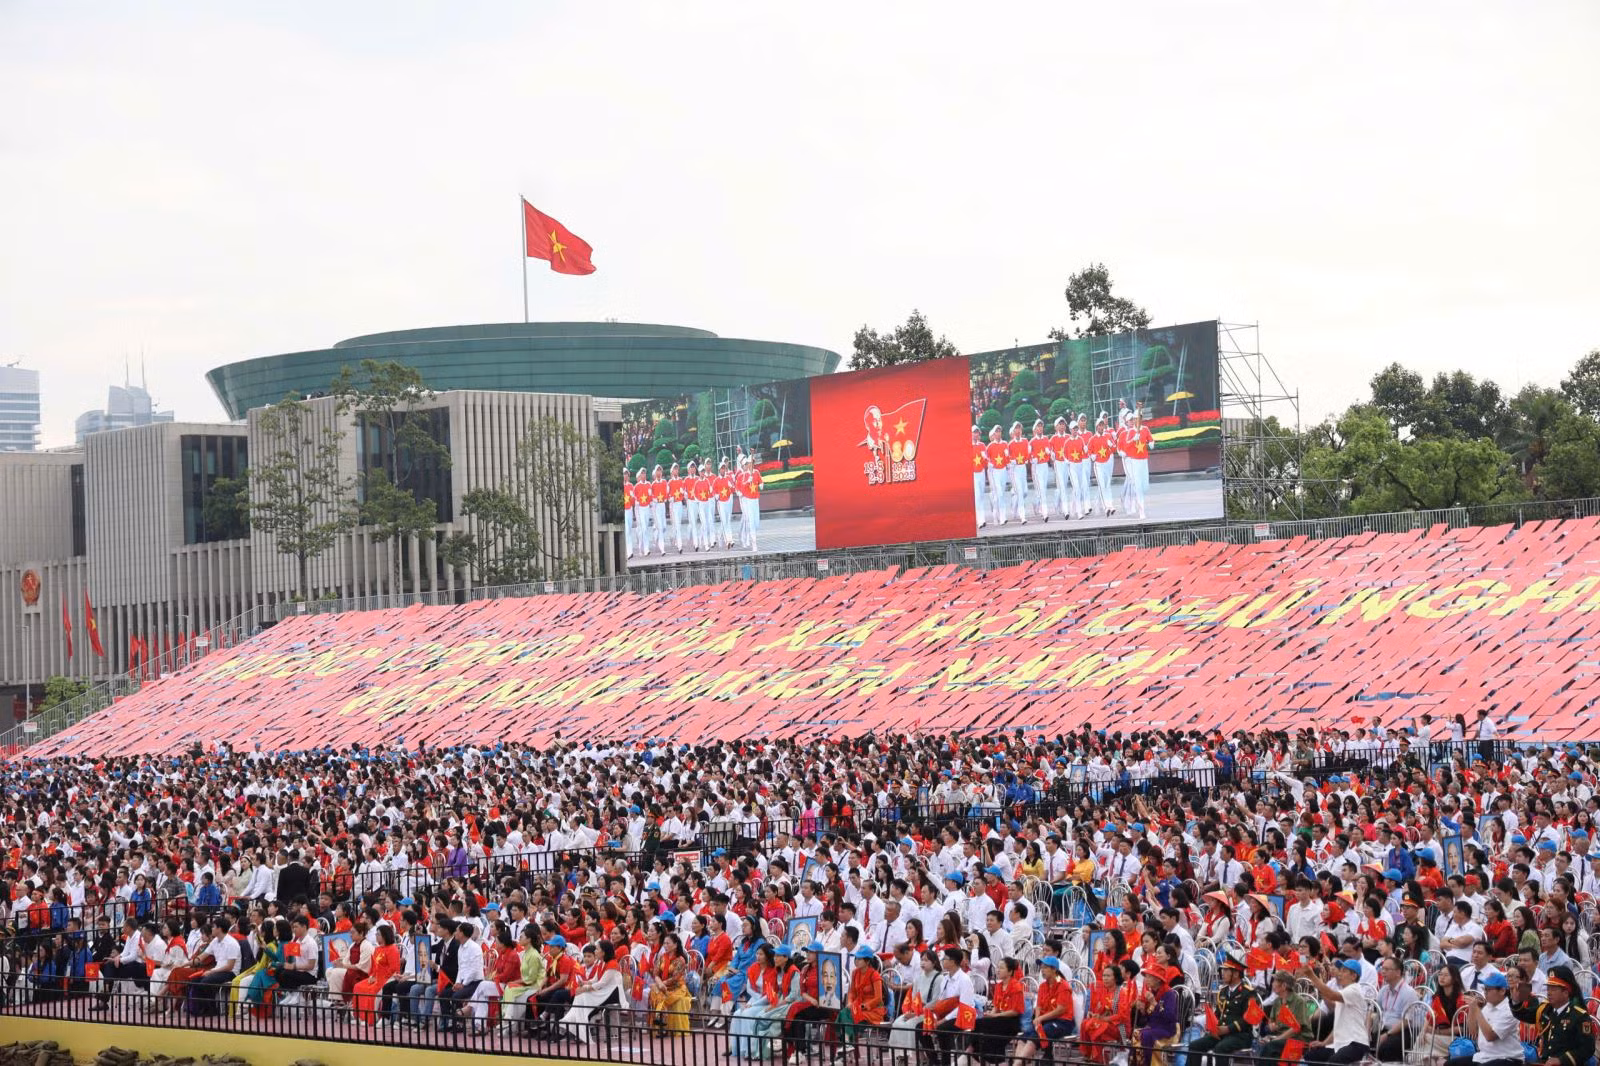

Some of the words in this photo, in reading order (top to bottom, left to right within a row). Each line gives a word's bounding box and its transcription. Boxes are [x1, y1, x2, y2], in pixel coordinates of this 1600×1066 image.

[892, 471, 916, 481] 2025
[750, 609, 905, 651] XÃ
[461, 673, 658, 710] NAM
